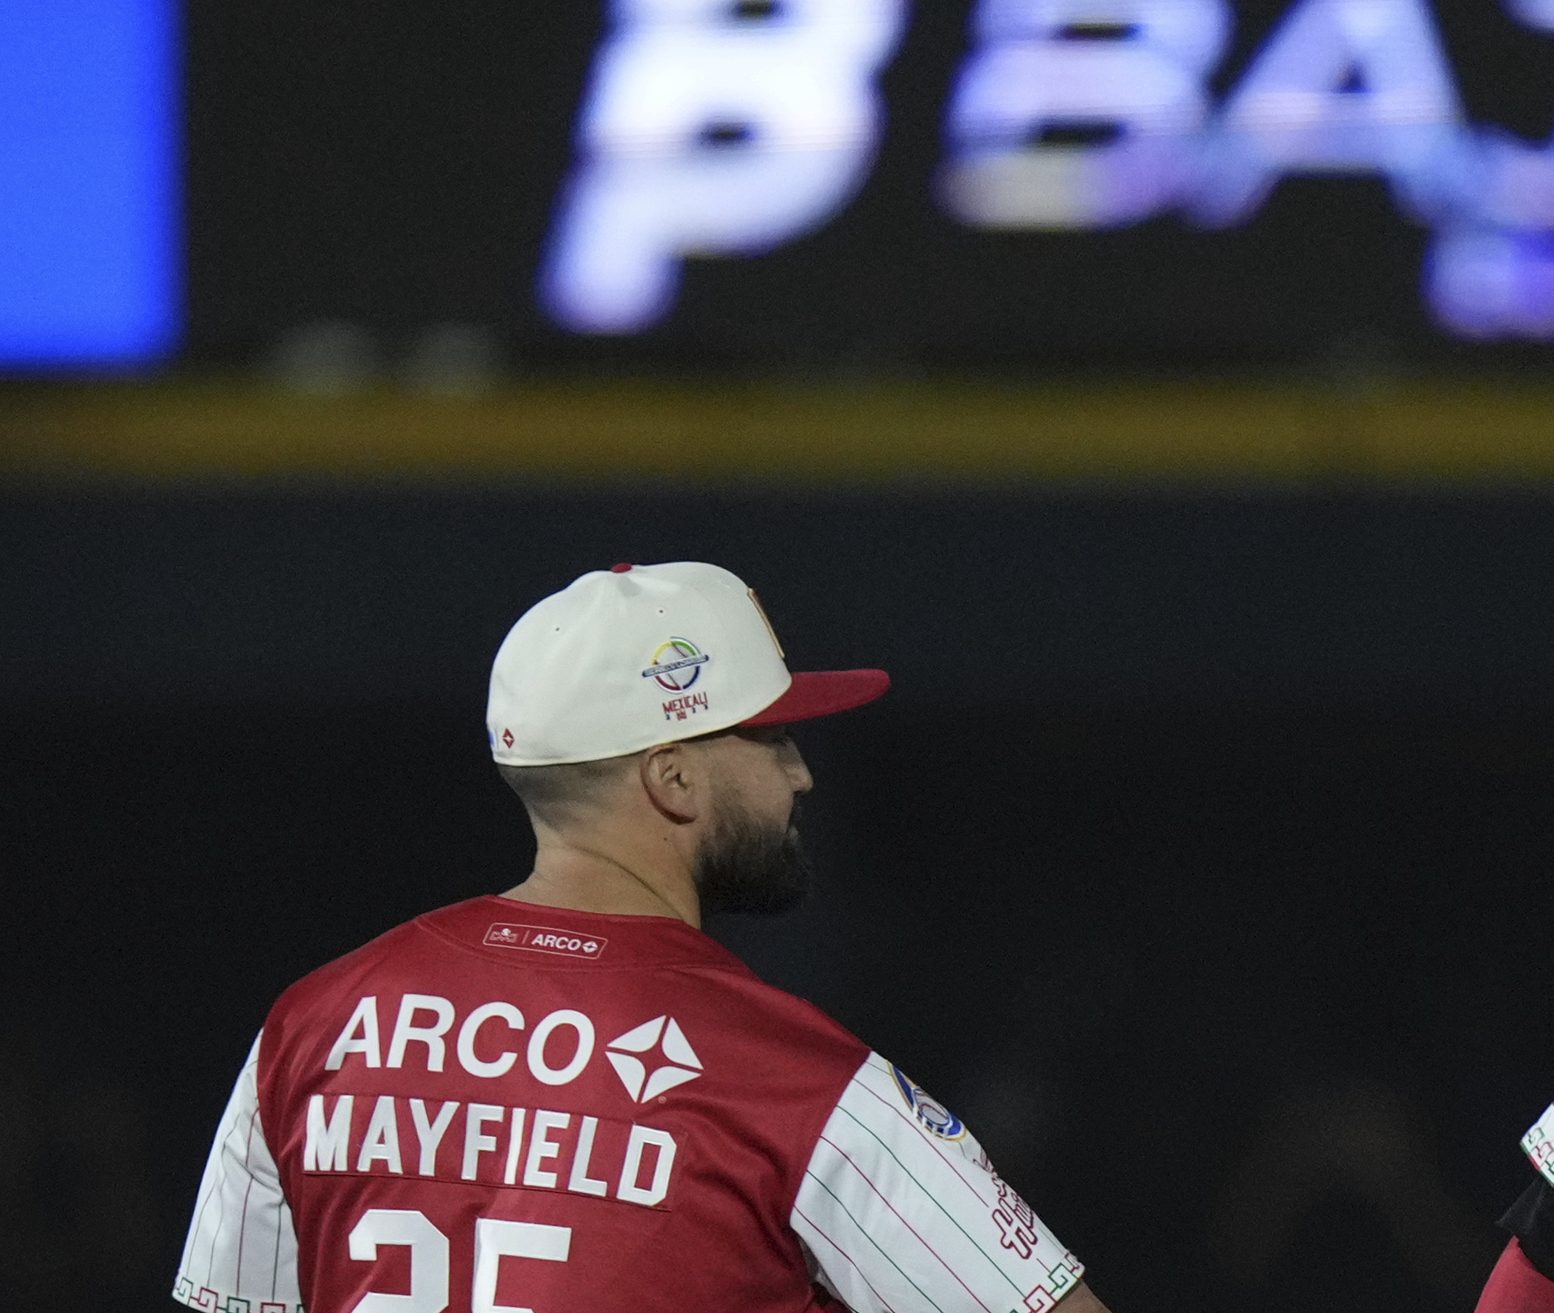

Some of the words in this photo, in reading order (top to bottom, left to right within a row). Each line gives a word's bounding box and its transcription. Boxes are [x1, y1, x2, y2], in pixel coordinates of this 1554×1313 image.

[531, 933, 581, 951] ARCO
[324, 993, 594, 1086] ARCO
[304, 1095, 677, 1207] MAYFIELD
